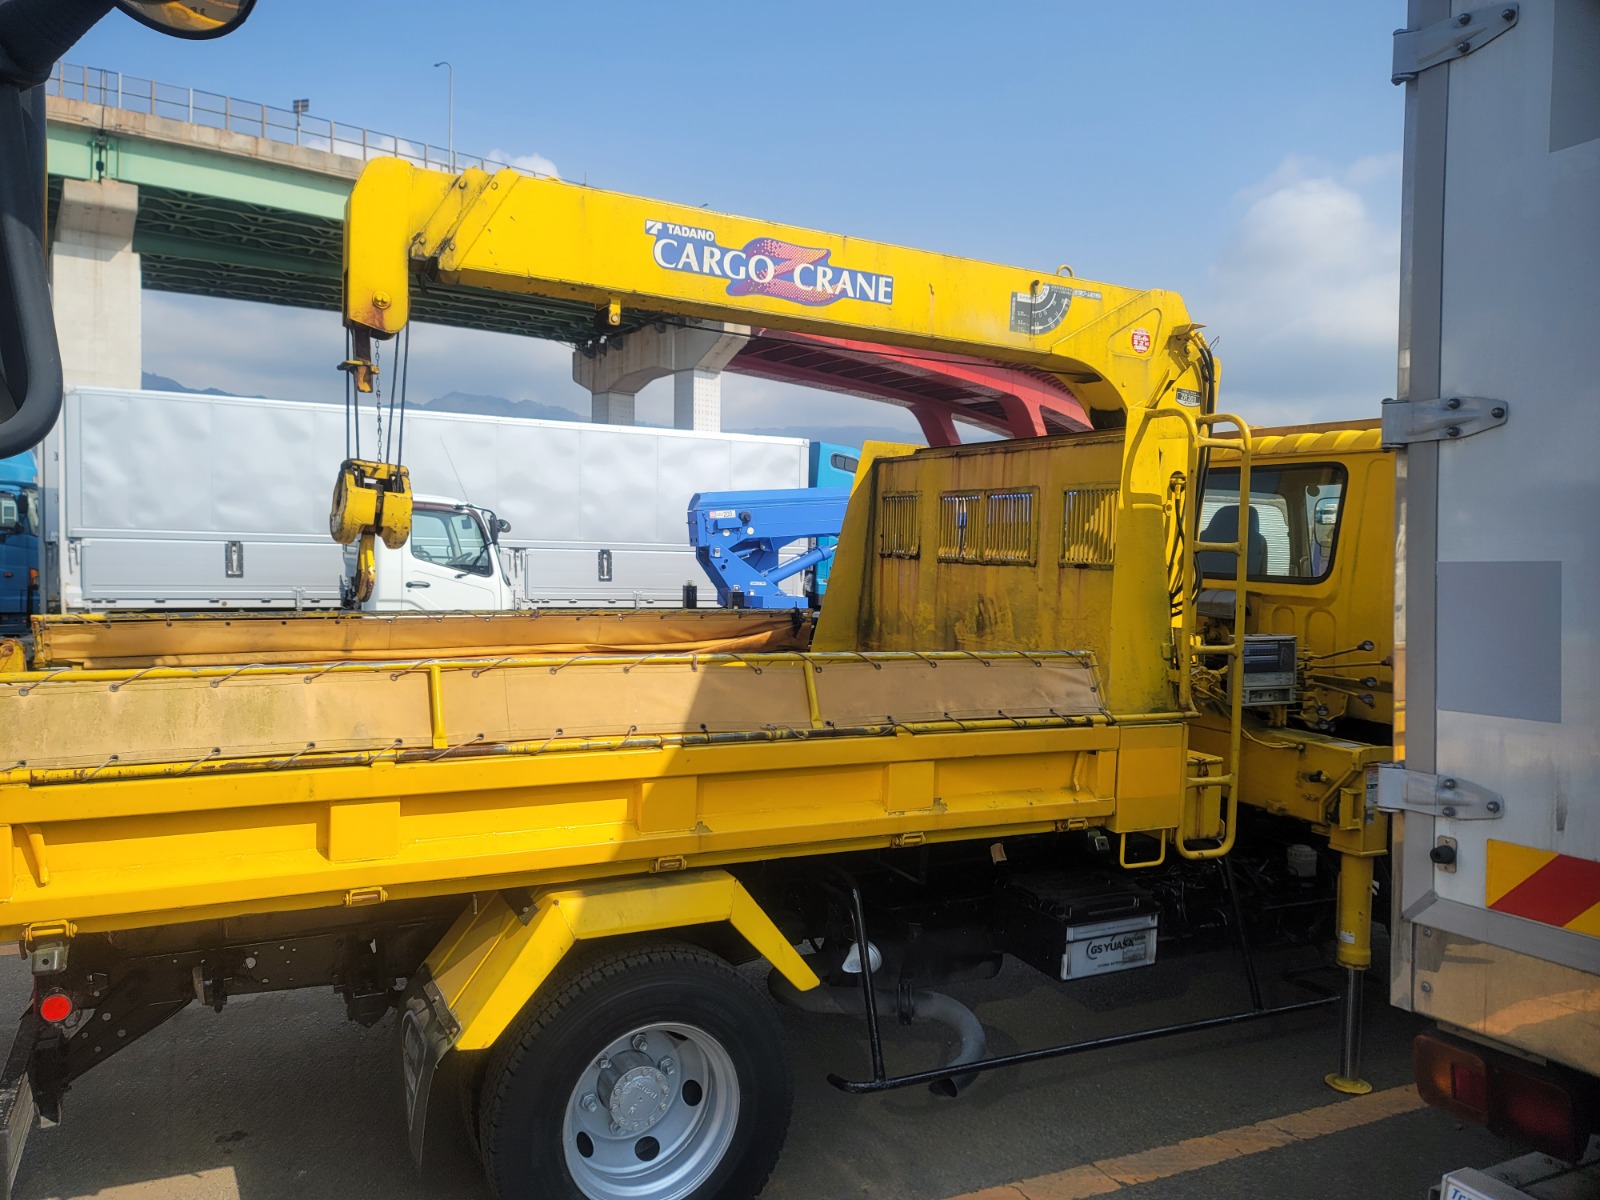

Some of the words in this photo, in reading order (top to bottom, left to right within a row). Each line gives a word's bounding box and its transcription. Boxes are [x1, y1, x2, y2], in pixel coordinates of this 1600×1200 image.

[667, 223, 714, 242] TADANO
[653, 238, 775, 283] CARGO
[793, 263, 893, 303] CRANE
[1090, 944, 1103, 955] GS
[1103, 938, 1134, 953] YUASA
